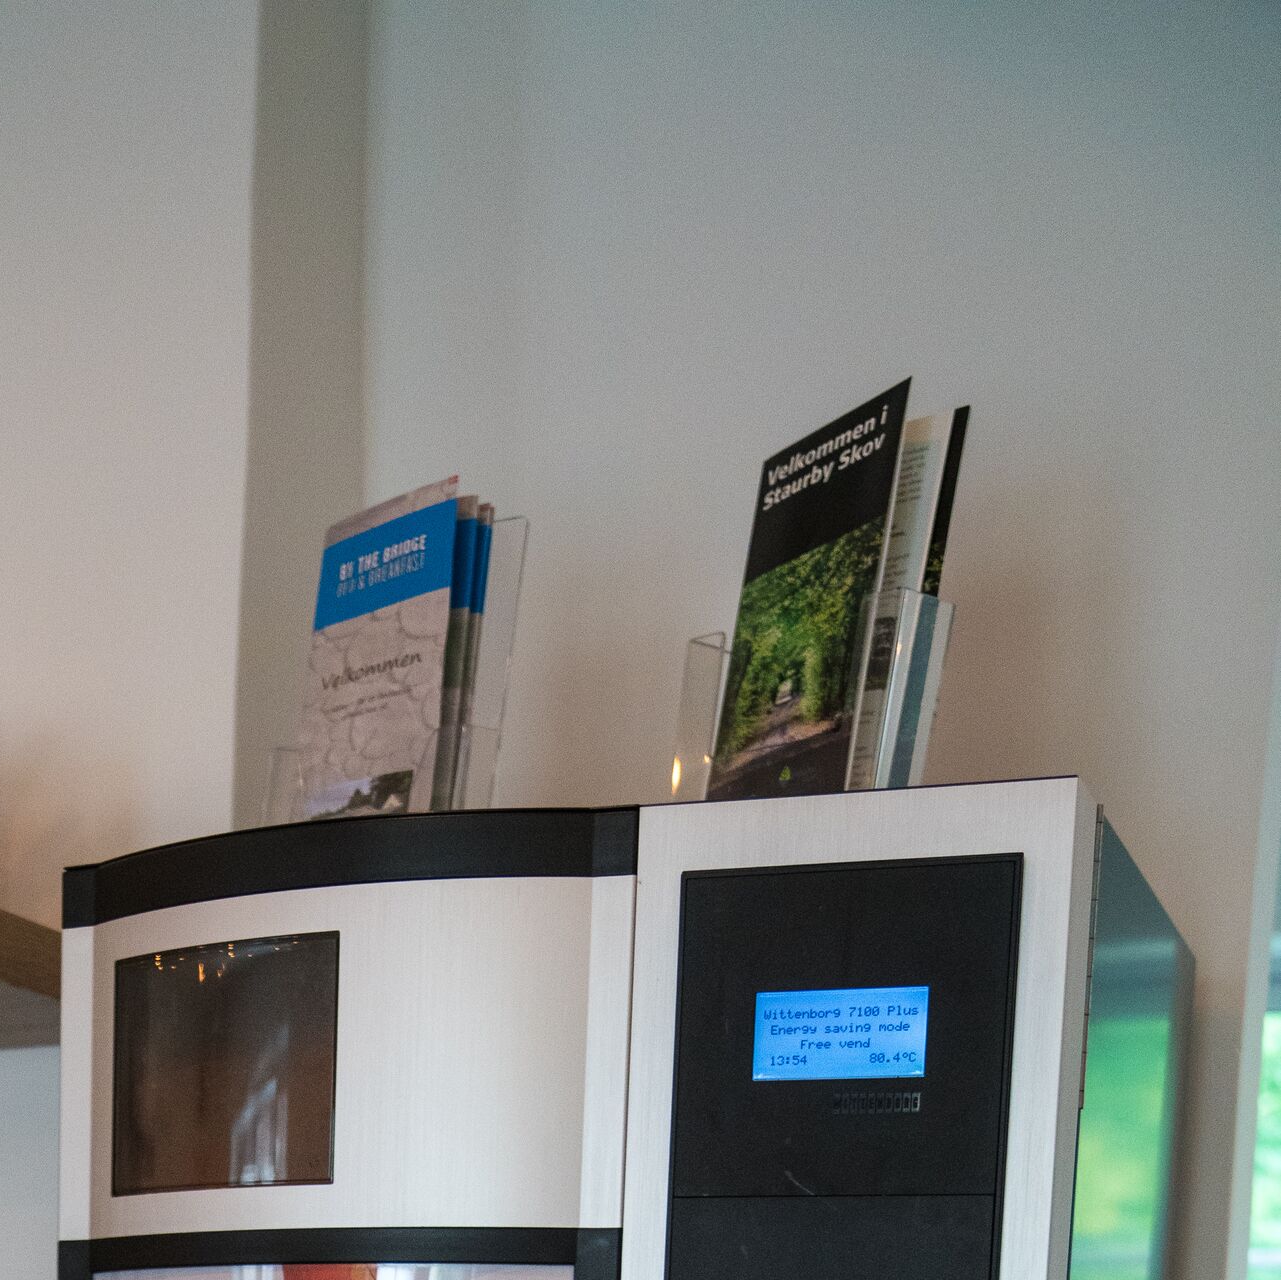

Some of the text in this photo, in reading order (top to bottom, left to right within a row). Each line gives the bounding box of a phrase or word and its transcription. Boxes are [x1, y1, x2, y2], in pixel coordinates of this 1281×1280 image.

[768, 416, 877, 486] Velkommen
[880, 404, 890, 425] i
[762, 433, 886, 511] Staurby Skov
[339, 534, 428, 582] BY THE BRIDGE
[368, 552, 425, 587] BREAKFAST
[763, 1005, 920, 1020] Wittenborg 7100 Plus
[770, 1021, 911, 1036] Energy saving mode
[800, 1037, 871, 1050] Free vend
[770, 1054, 808, 1066] 13:54
